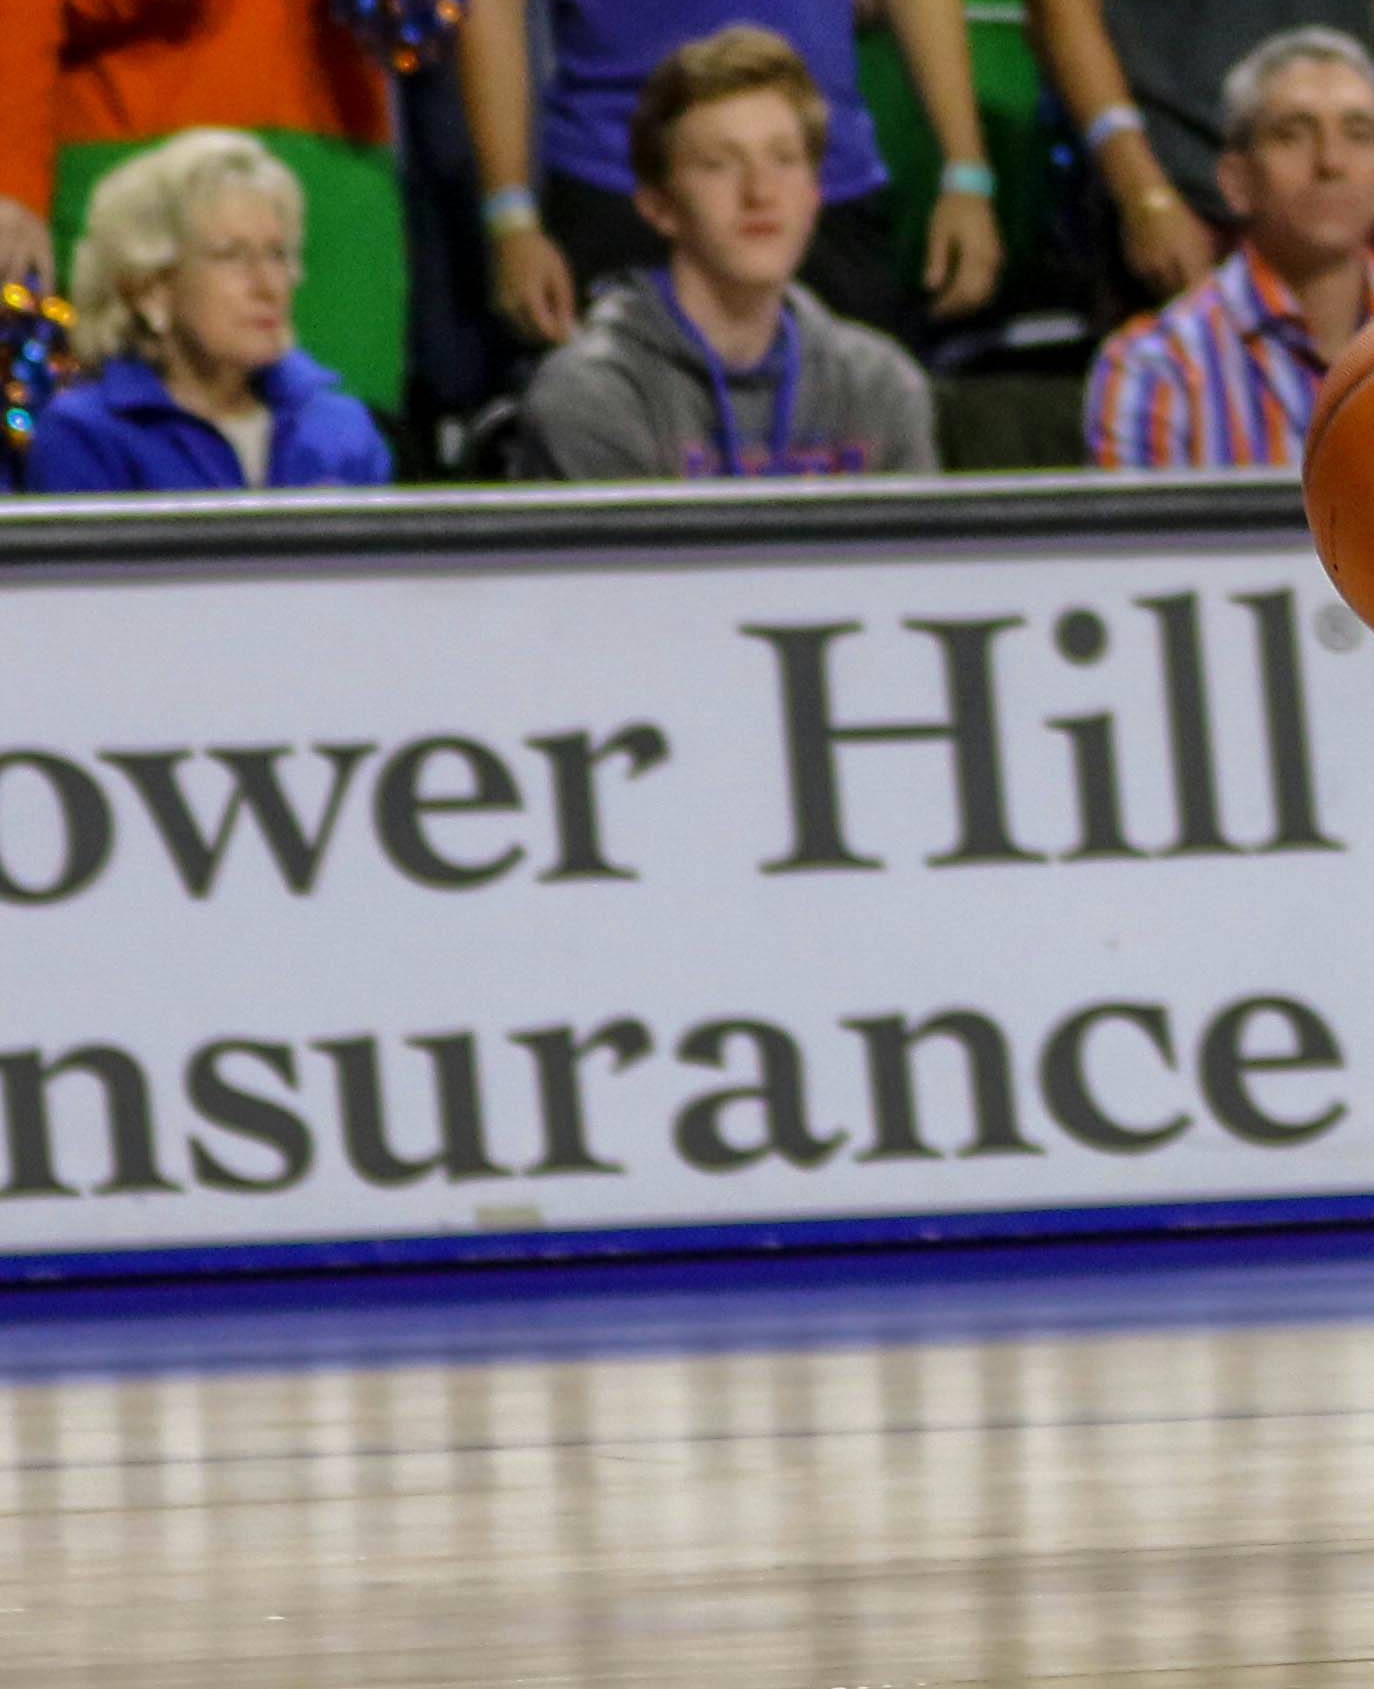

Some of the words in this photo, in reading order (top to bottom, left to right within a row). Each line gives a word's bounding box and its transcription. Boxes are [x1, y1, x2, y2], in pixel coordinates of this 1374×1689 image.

[0, 720, 672, 907] ower
[738, 587, 1348, 875] Hill
[0, 991, 1350, 1197] nsurance
